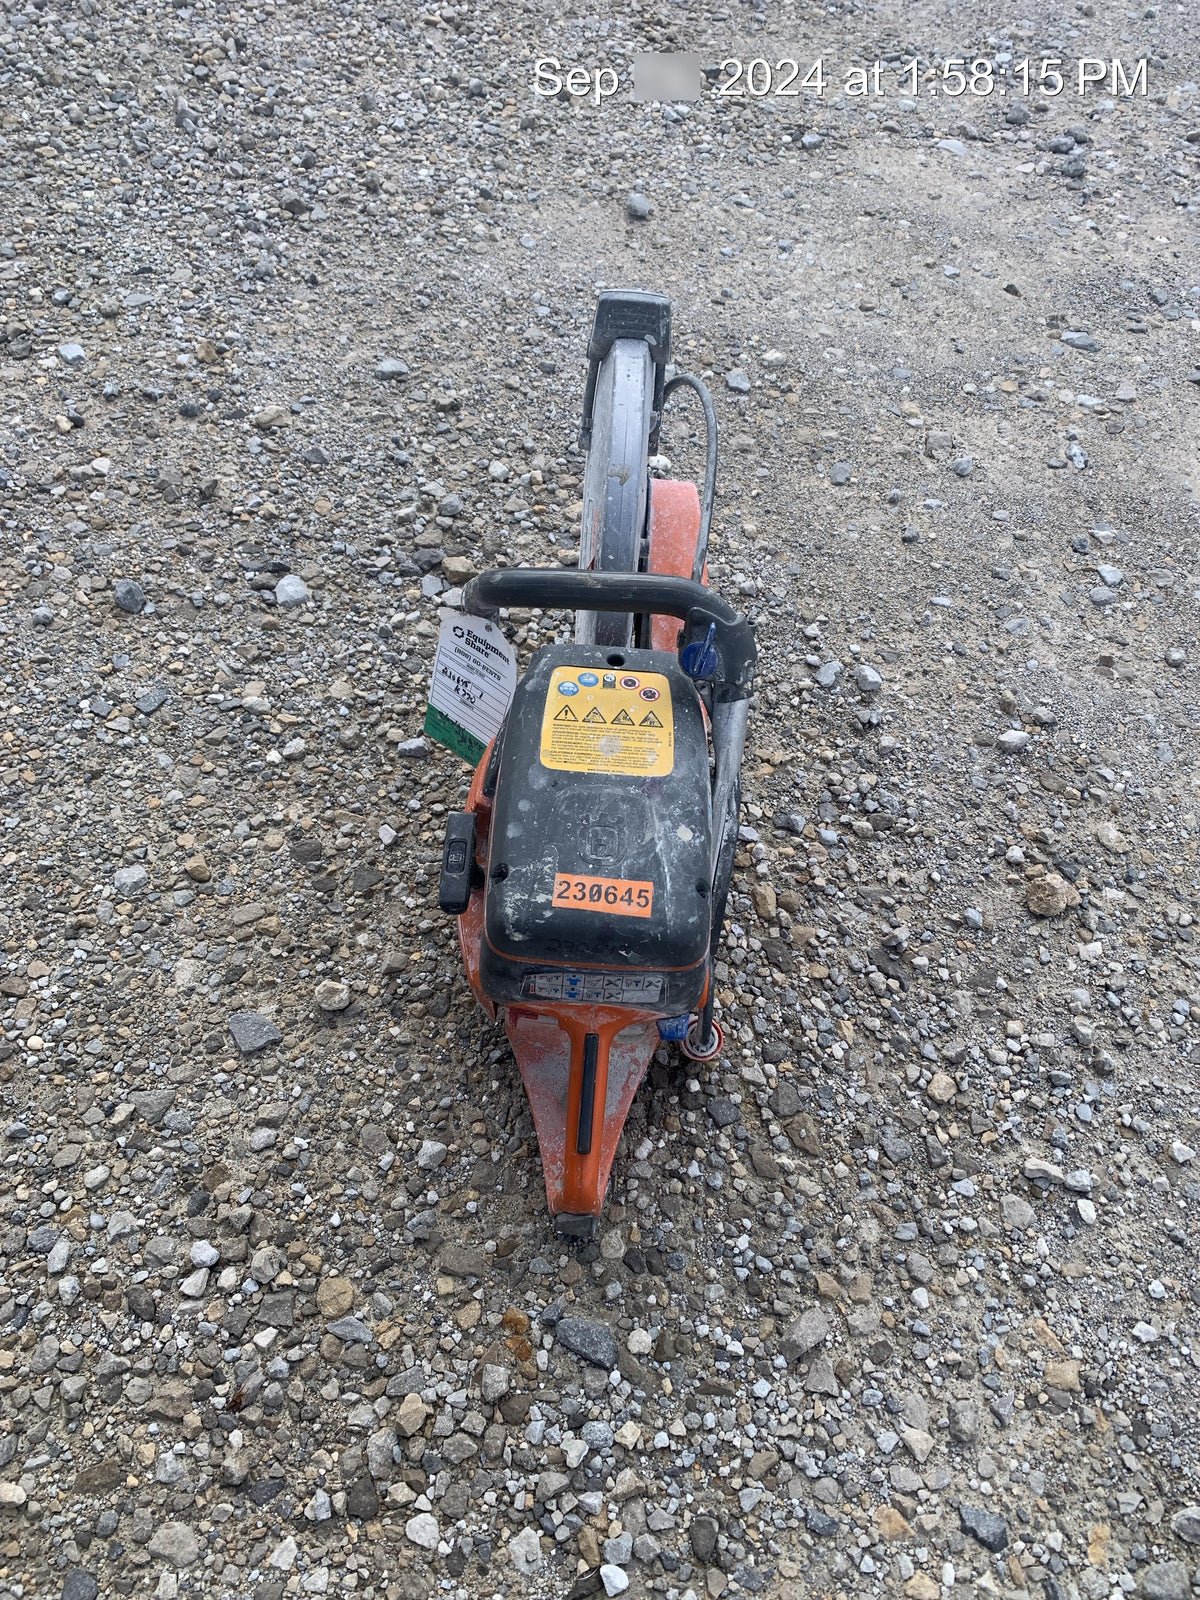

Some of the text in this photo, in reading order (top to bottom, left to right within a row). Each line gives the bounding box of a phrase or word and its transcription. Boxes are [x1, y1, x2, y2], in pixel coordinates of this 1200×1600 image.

[464, 637, 490, 658] Share
[466, 629, 510, 665] Equipment
[556, 880, 650, 908] 230645
